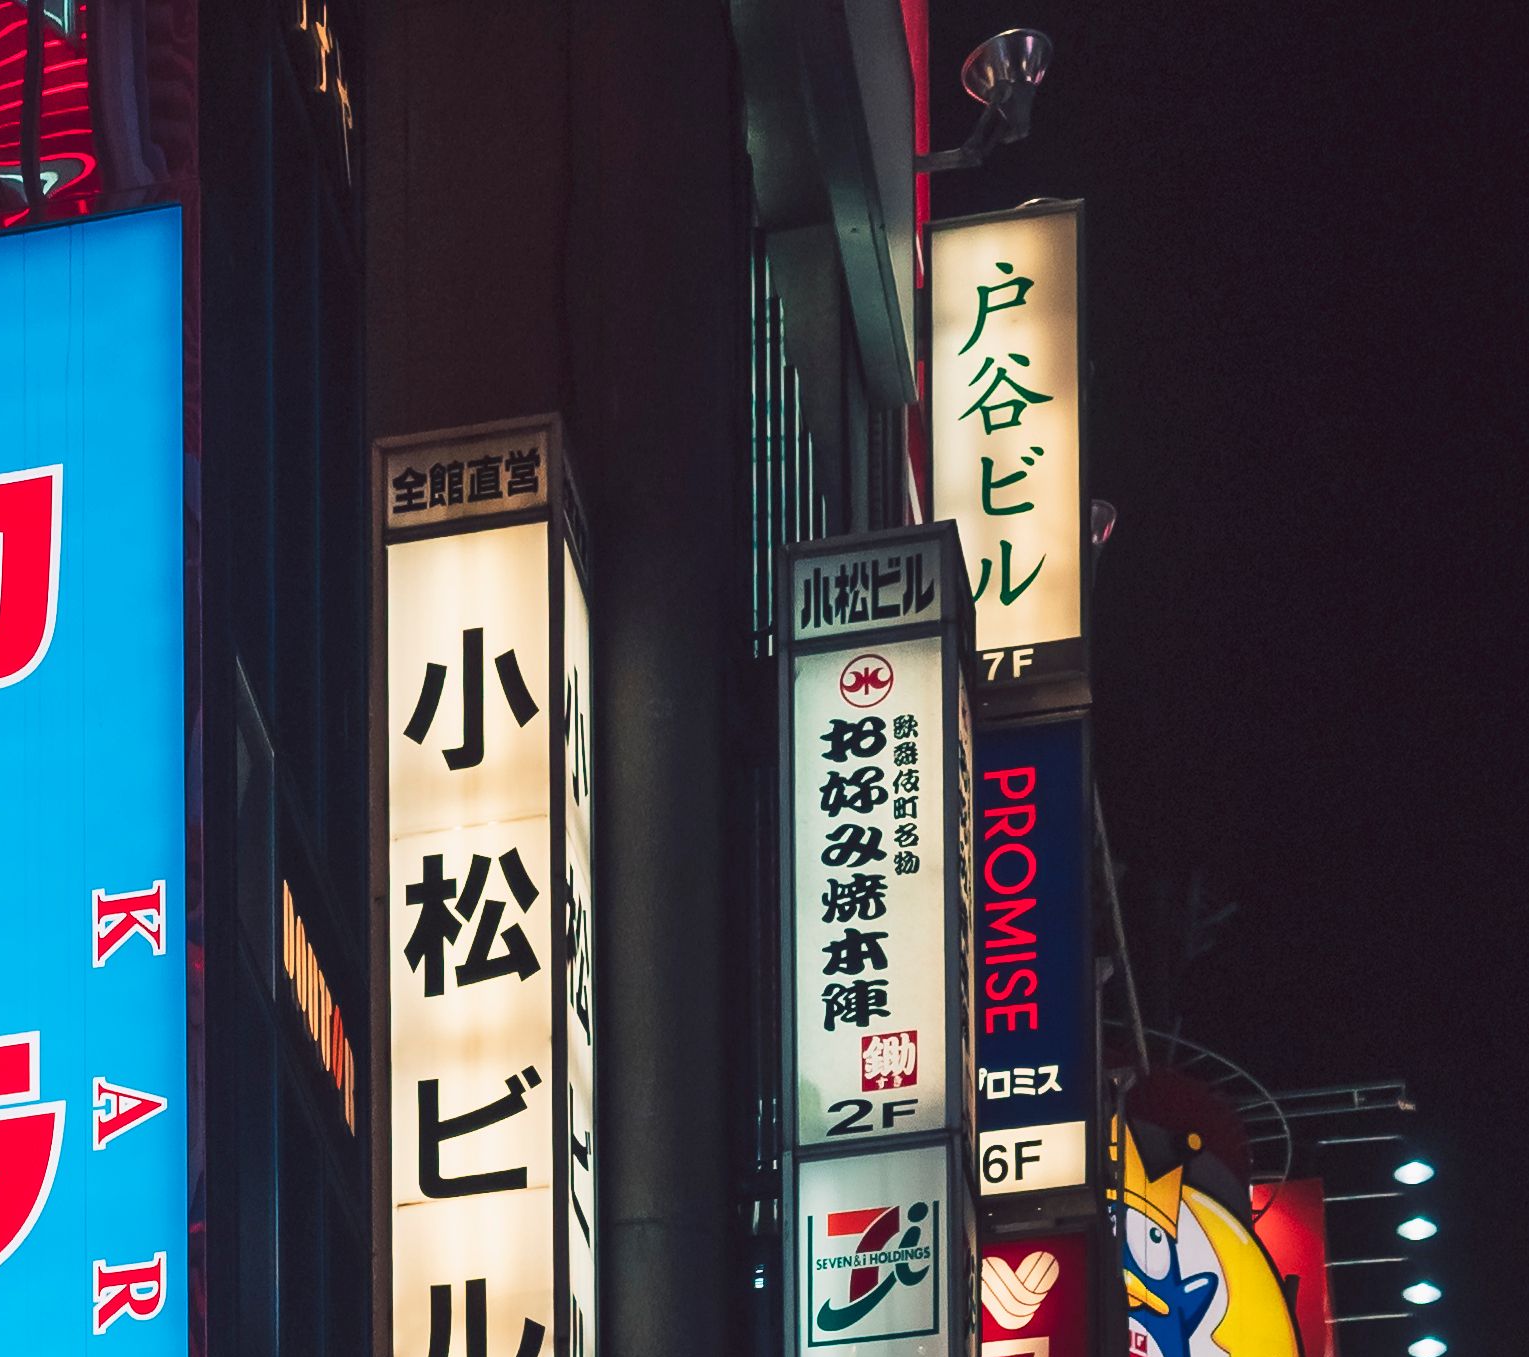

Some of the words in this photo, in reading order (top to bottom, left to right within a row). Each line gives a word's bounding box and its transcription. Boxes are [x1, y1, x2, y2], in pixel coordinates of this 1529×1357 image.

[392, 447, 540, 514] 全館直営
[801, 553, 935, 629] 小松ビル
[983, 649, 1034, 681] 7F
[983, 766, 1038, 1034] PROMISE
[826, 1099, 919, 1137] 2F
[982, 1140, 1043, 1184] 6F
[869, 1246, 931, 1265] HOLDINGS
